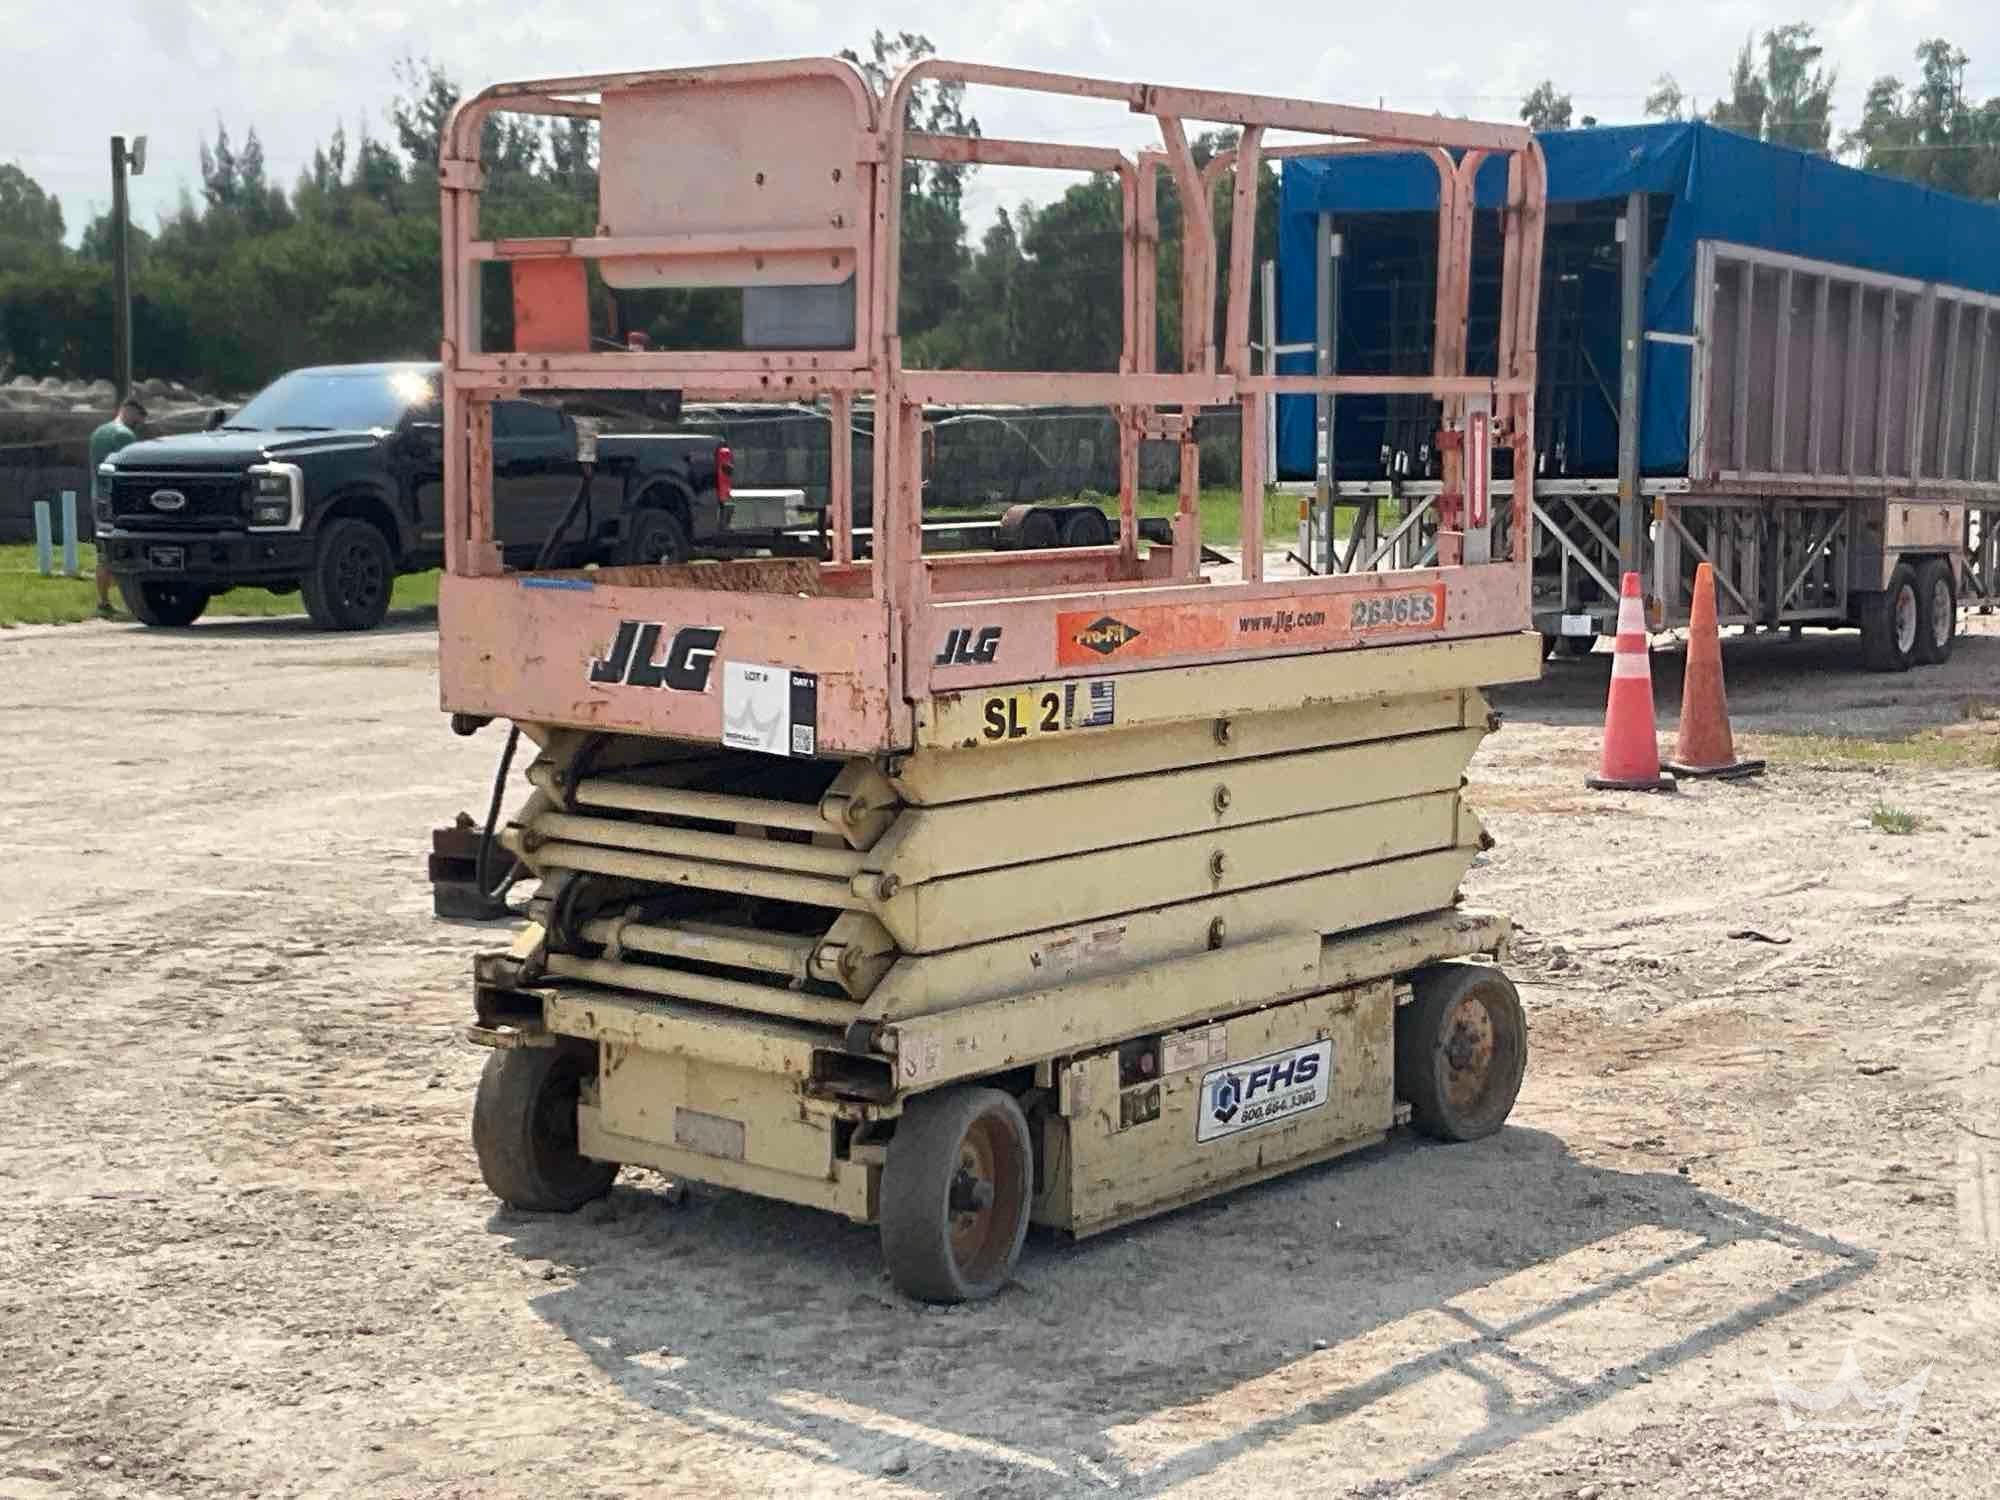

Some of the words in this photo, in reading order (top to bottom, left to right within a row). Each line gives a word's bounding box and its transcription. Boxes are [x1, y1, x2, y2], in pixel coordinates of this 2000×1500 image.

[1239, 609, 1326, 633] www.jlg.com
[588, 619, 723, 692] JLG
[935, 626, 1003, 665] JLG
[984, 697, 1027, 738] SL
[1245, 1053, 1321, 1099] FHS
